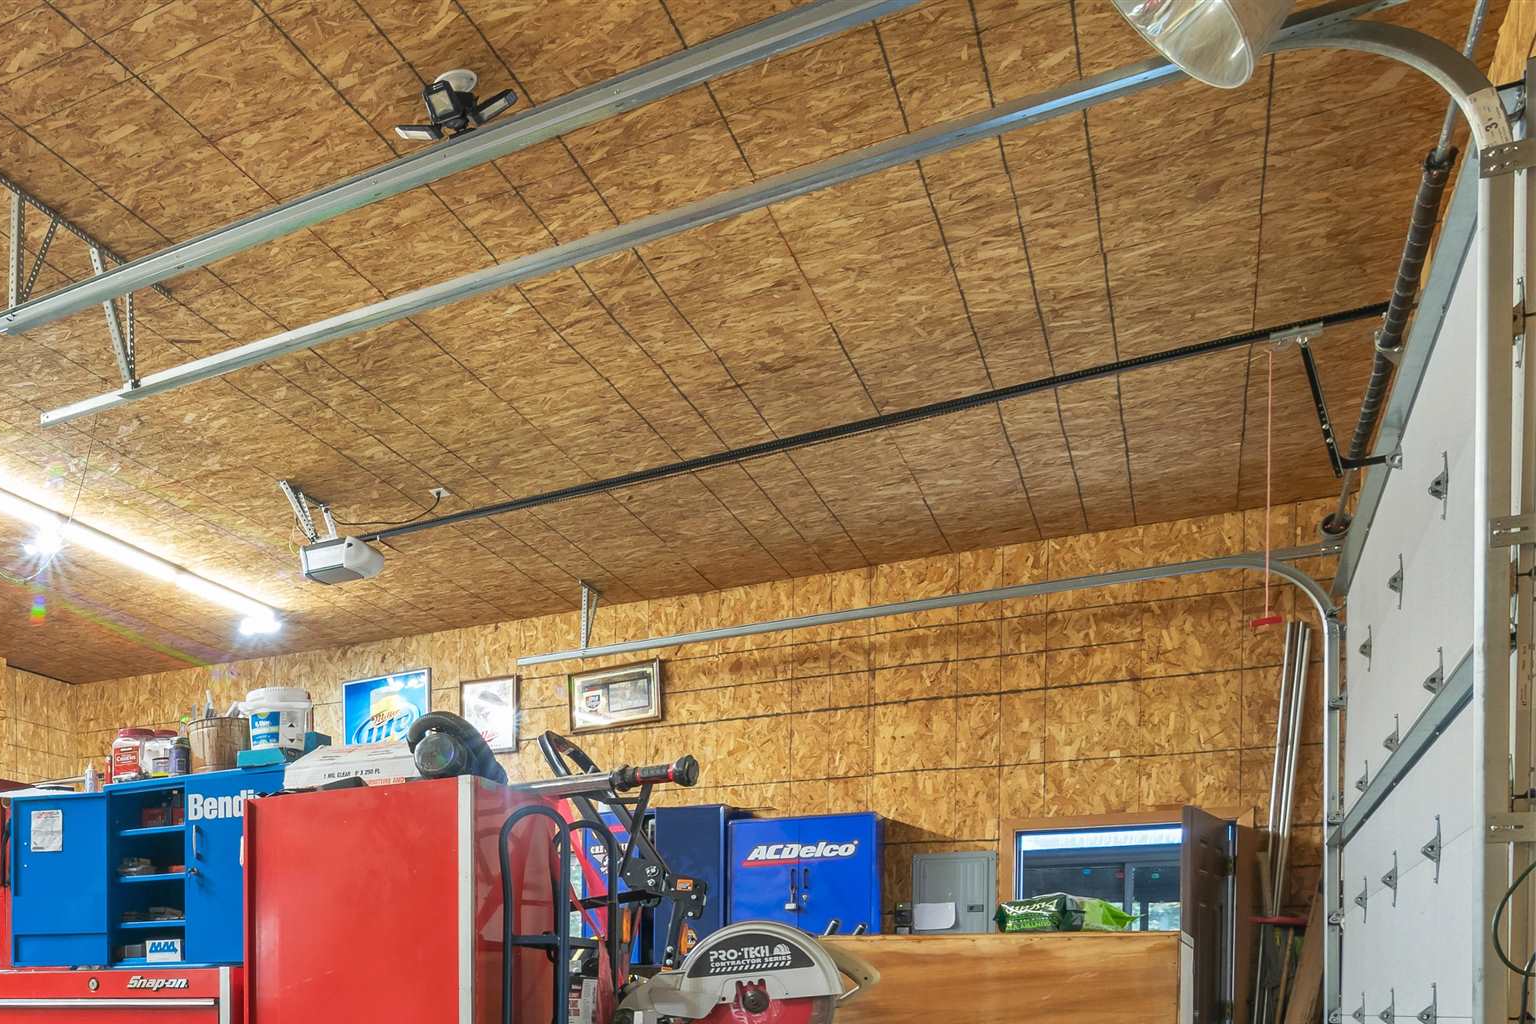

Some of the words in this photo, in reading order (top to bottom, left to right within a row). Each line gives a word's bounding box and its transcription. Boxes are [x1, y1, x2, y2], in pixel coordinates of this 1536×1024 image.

[747, 841, 856, 860] ACDelco
[710, 958, 763, 968] CONTRACTOR
[765, 955, 792, 963] SERIES
[128, 976, 189, 991] Snap-on
